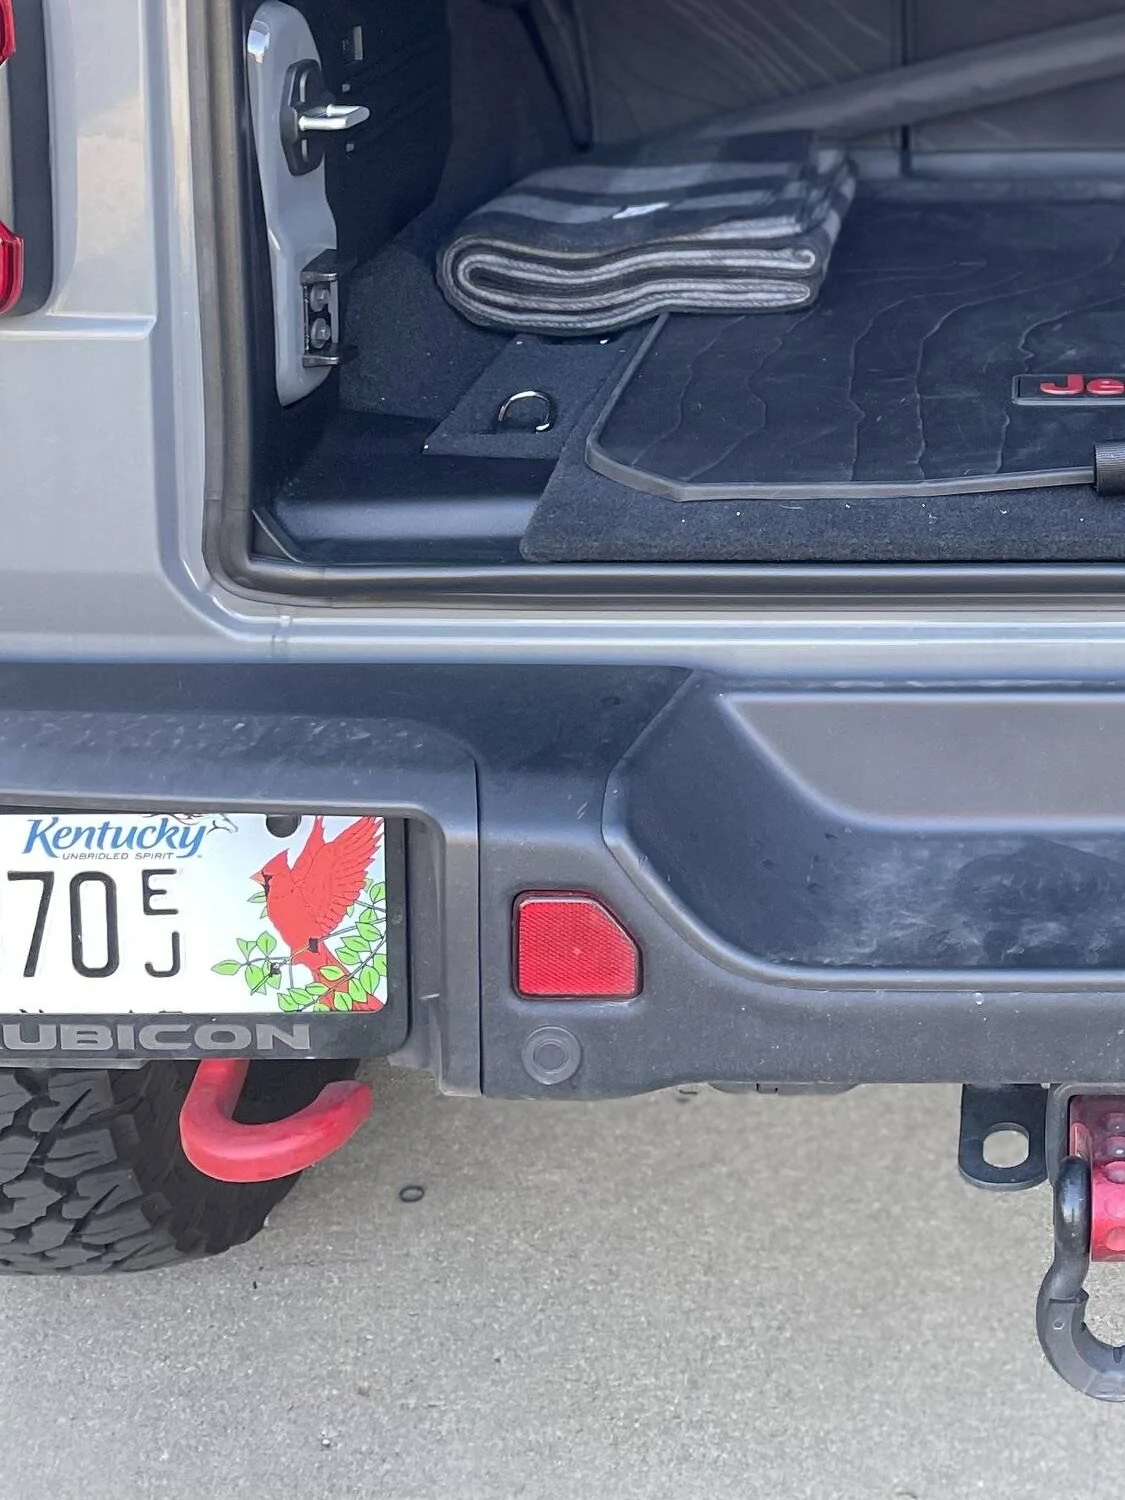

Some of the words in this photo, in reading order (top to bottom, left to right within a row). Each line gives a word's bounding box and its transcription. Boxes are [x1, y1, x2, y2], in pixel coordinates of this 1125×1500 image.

[21, 815, 207, 859] Kentucky
[62, 852, 129, 861] UNBRIDLED
[134, 852, 174, 861] SPIRIT
[0, 1023, 310, 1051] UBICON
